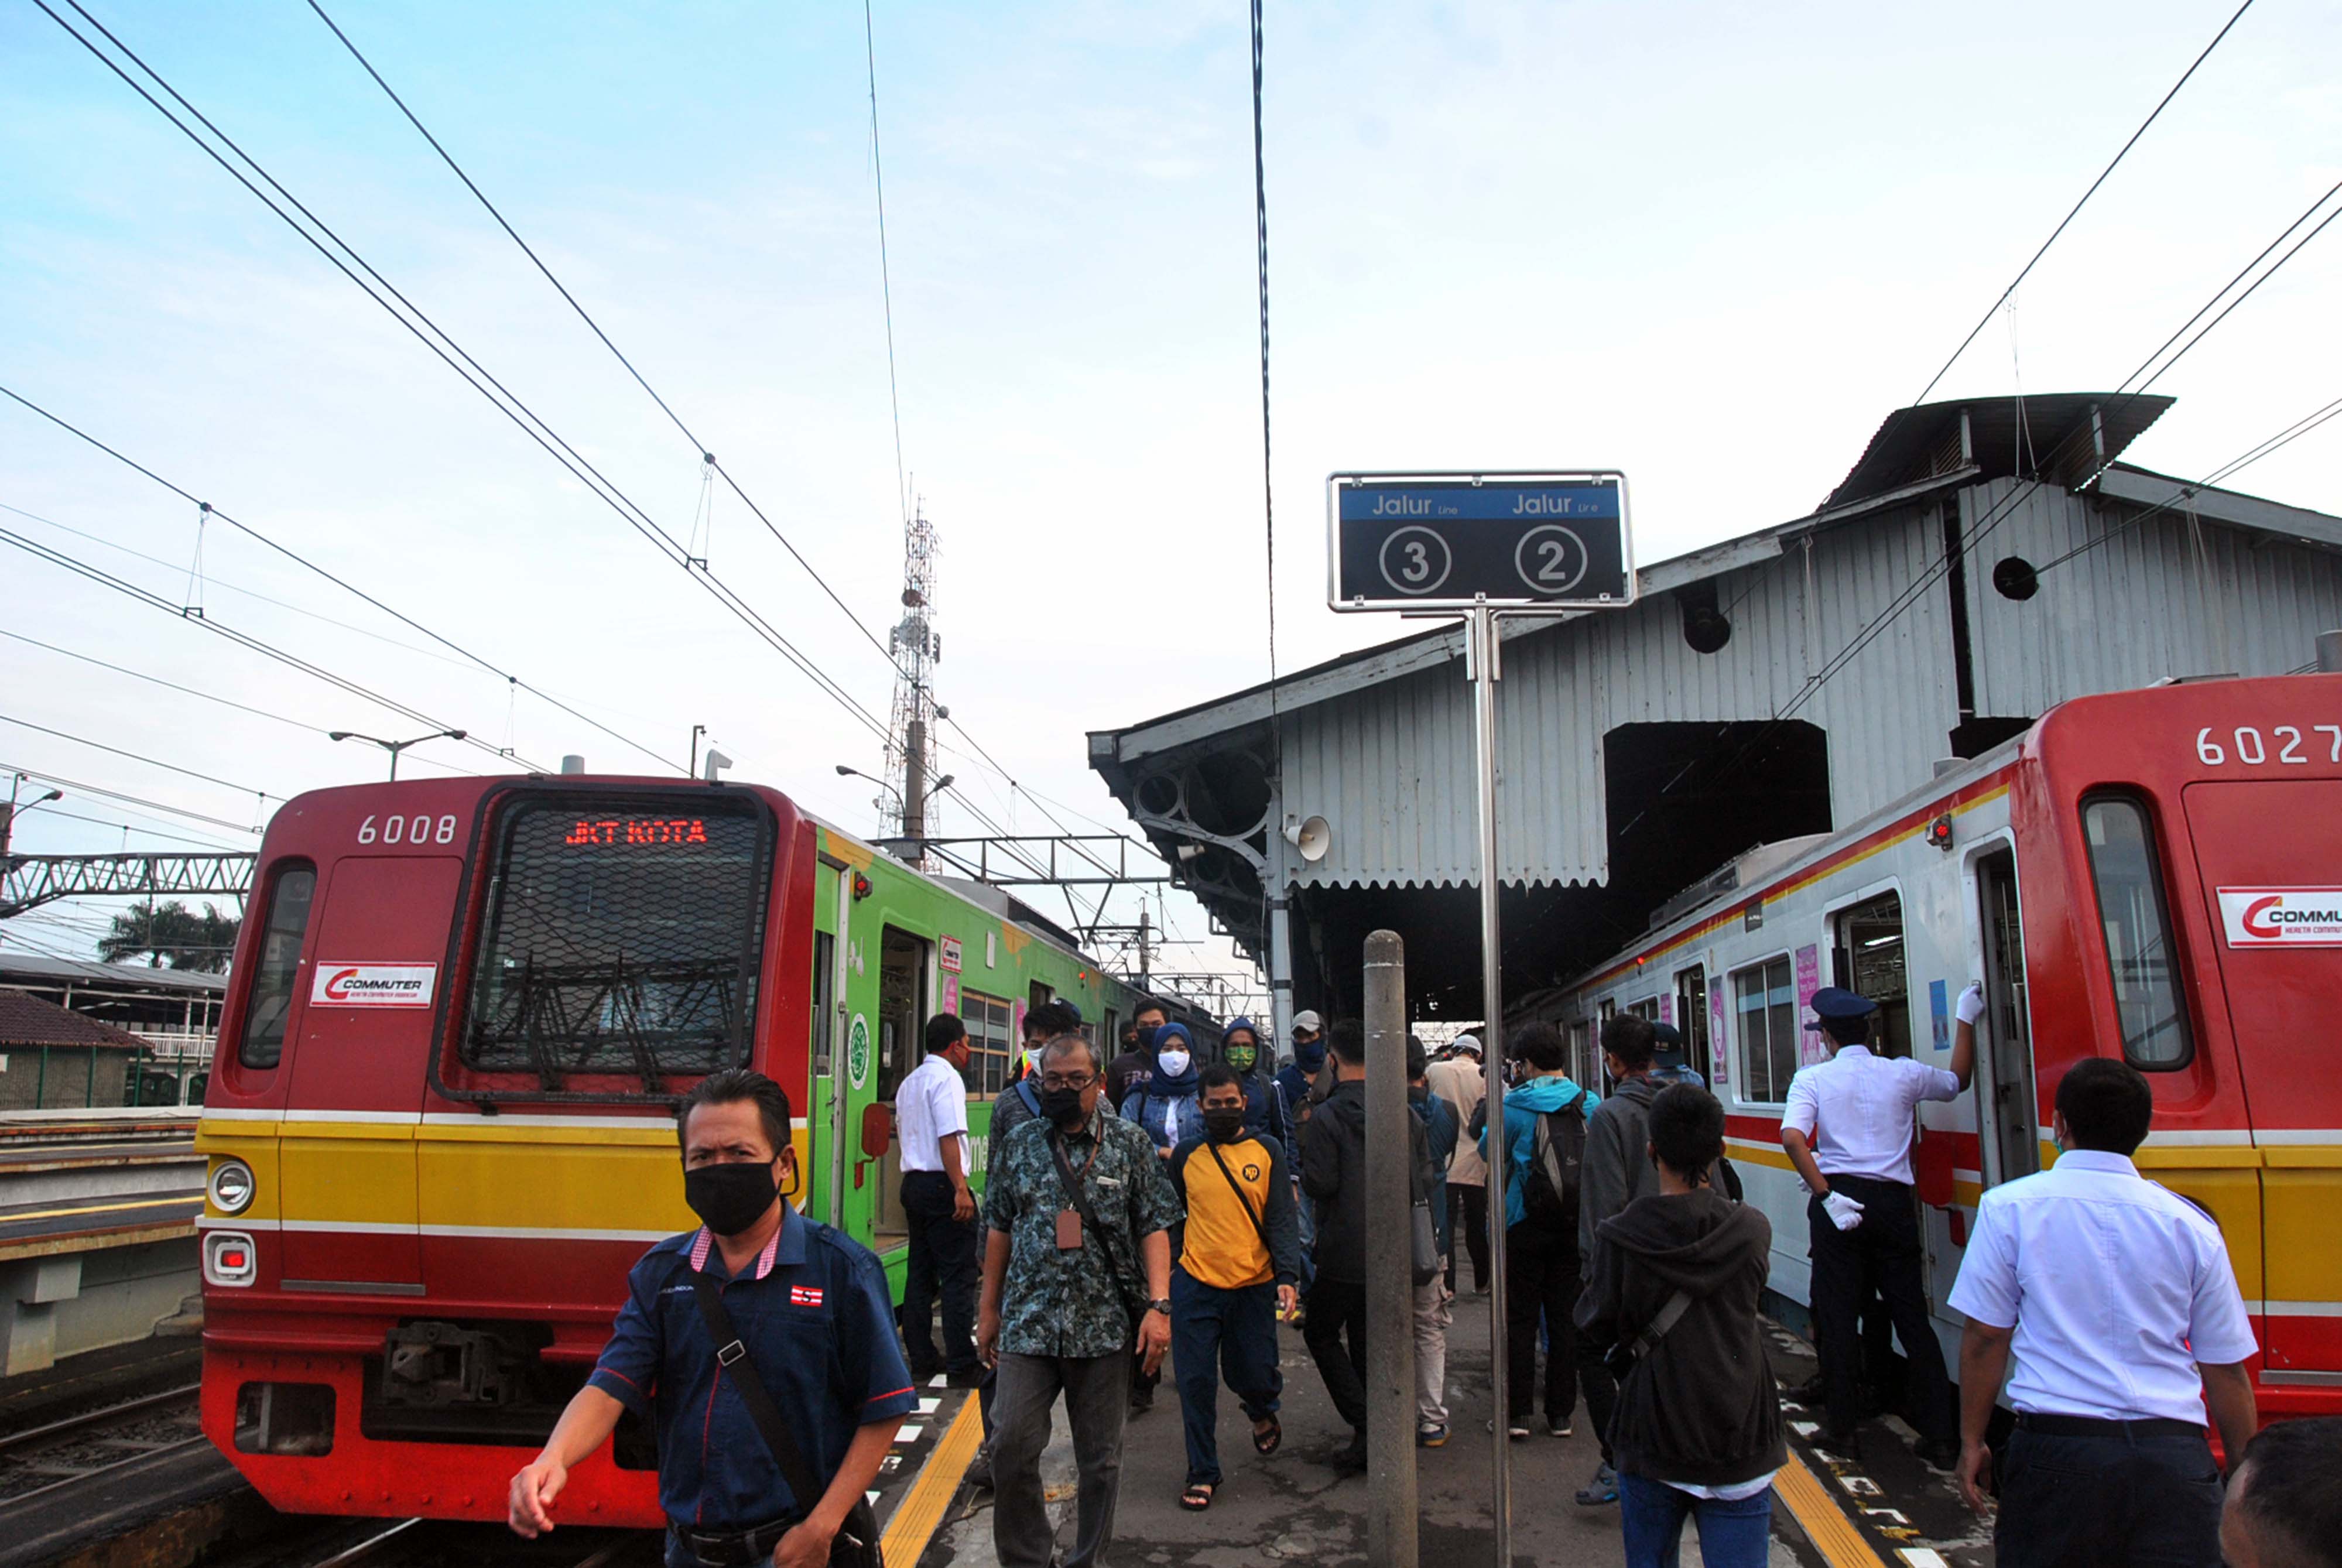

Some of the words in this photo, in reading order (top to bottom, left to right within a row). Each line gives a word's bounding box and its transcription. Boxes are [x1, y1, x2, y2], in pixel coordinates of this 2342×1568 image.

[1372, 495, 1432, 516] Jalur
[1437, 505, 1458, 515] Line
[1512, 494, 1571, 515] Jalur
[1402, 541, 1430, 582] 3
[1538, 540, 1566, 581] 2
[2196, 725, 2342, 766] 6027
[357, 814, 457, 844] 6008
[565, 821, 619, 844] JKT
[627, 820, 707, 843] KOTA
[343, 980, 422, 990] COMMUTER
